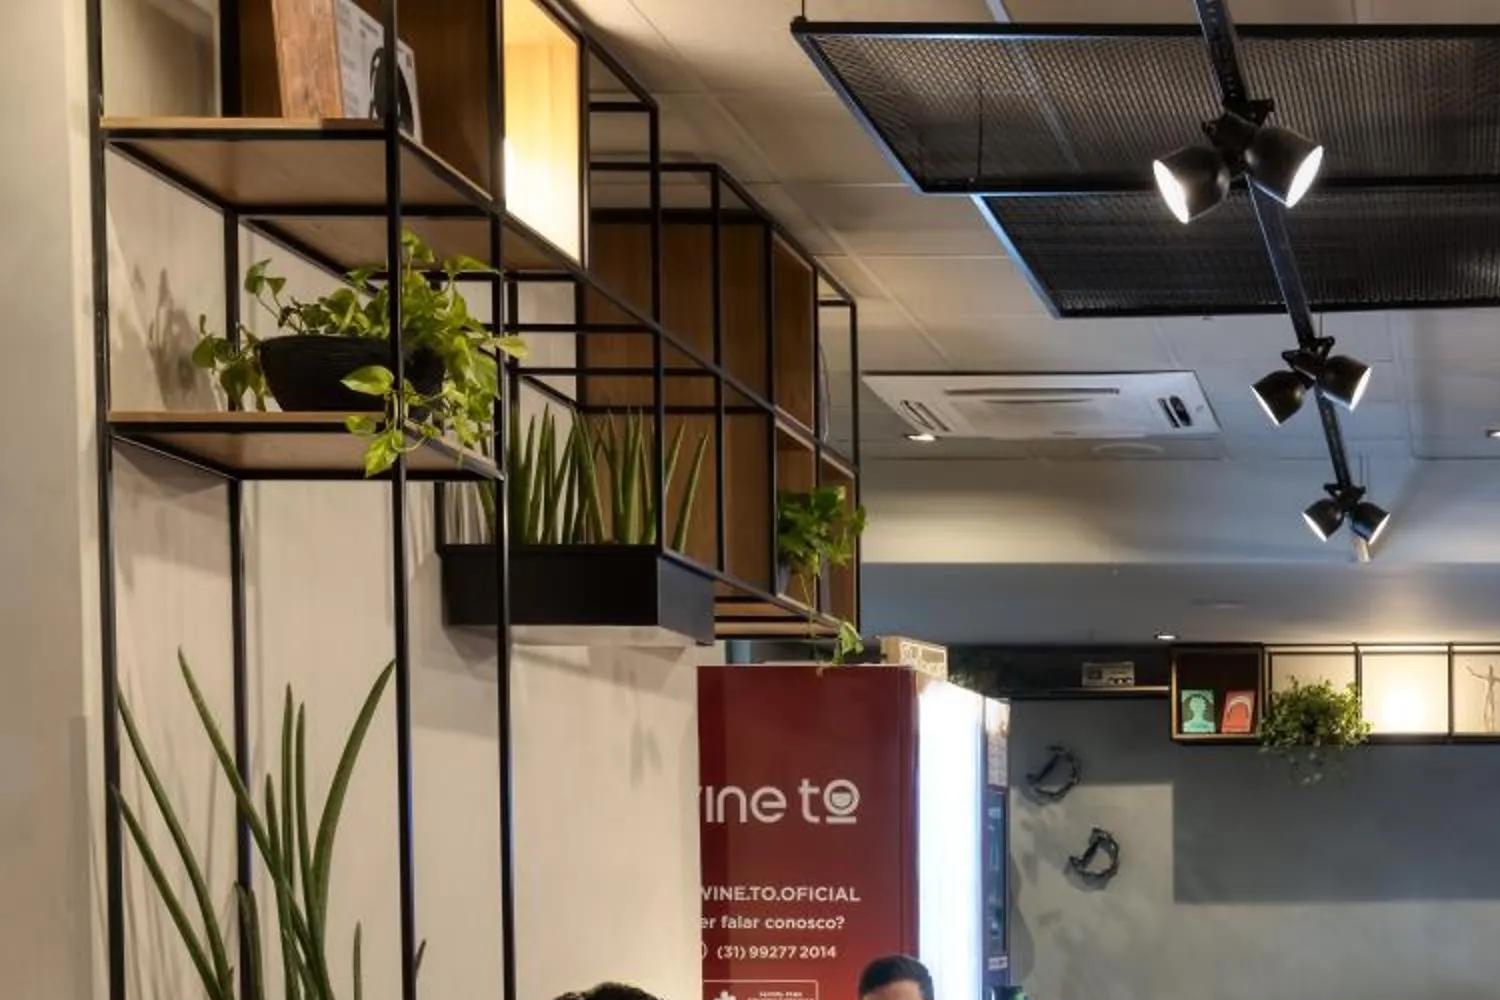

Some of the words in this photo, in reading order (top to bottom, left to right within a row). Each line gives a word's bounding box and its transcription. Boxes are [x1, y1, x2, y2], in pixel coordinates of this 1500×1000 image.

[696, 785, 787, 823] ine
[720, 915, 760, 929] falar
[765, 915, 846, 929] conosco?
[717, 945, 746, 960] (31)
[799, 945, 838, 959] 2014
